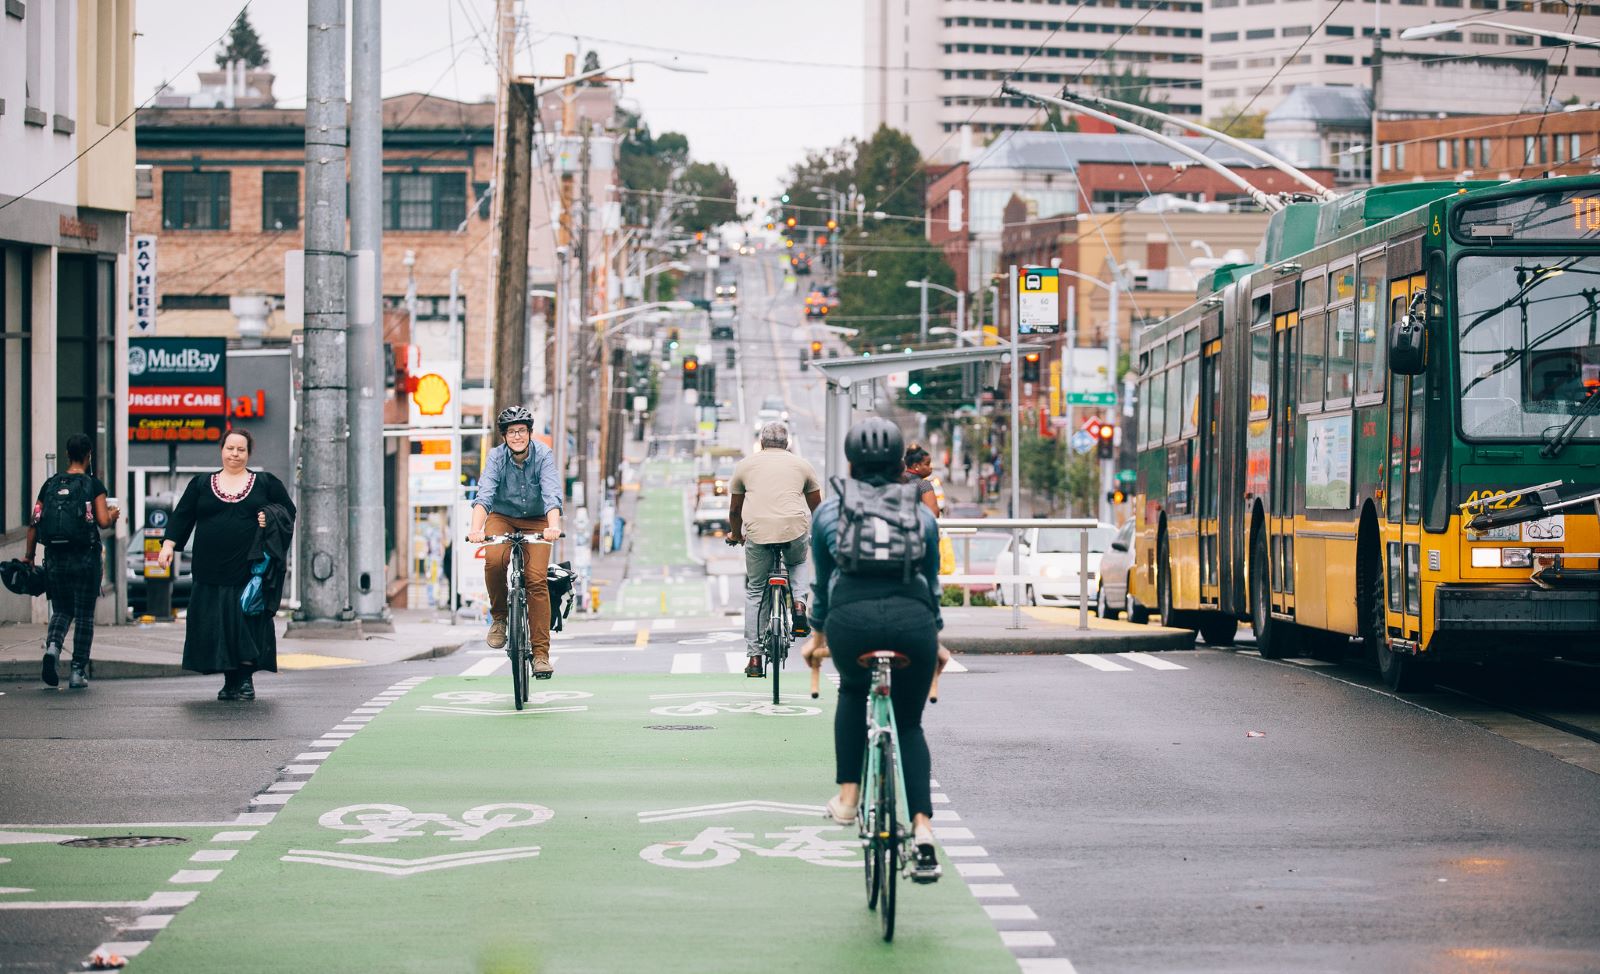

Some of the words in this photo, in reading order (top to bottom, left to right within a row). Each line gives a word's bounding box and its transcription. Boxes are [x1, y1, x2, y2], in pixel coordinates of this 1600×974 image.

[137, 240, 150, 271] PAY
[137, 276, 150, 318] HERE
[147, 348, 220, 372] MudBay
[183, 393, 222, 406] CARE
[139, 419, 183, 429] Capitol
[185, 419, 206, 427] Hill
[1465, 490, 1522, 510] 4222
